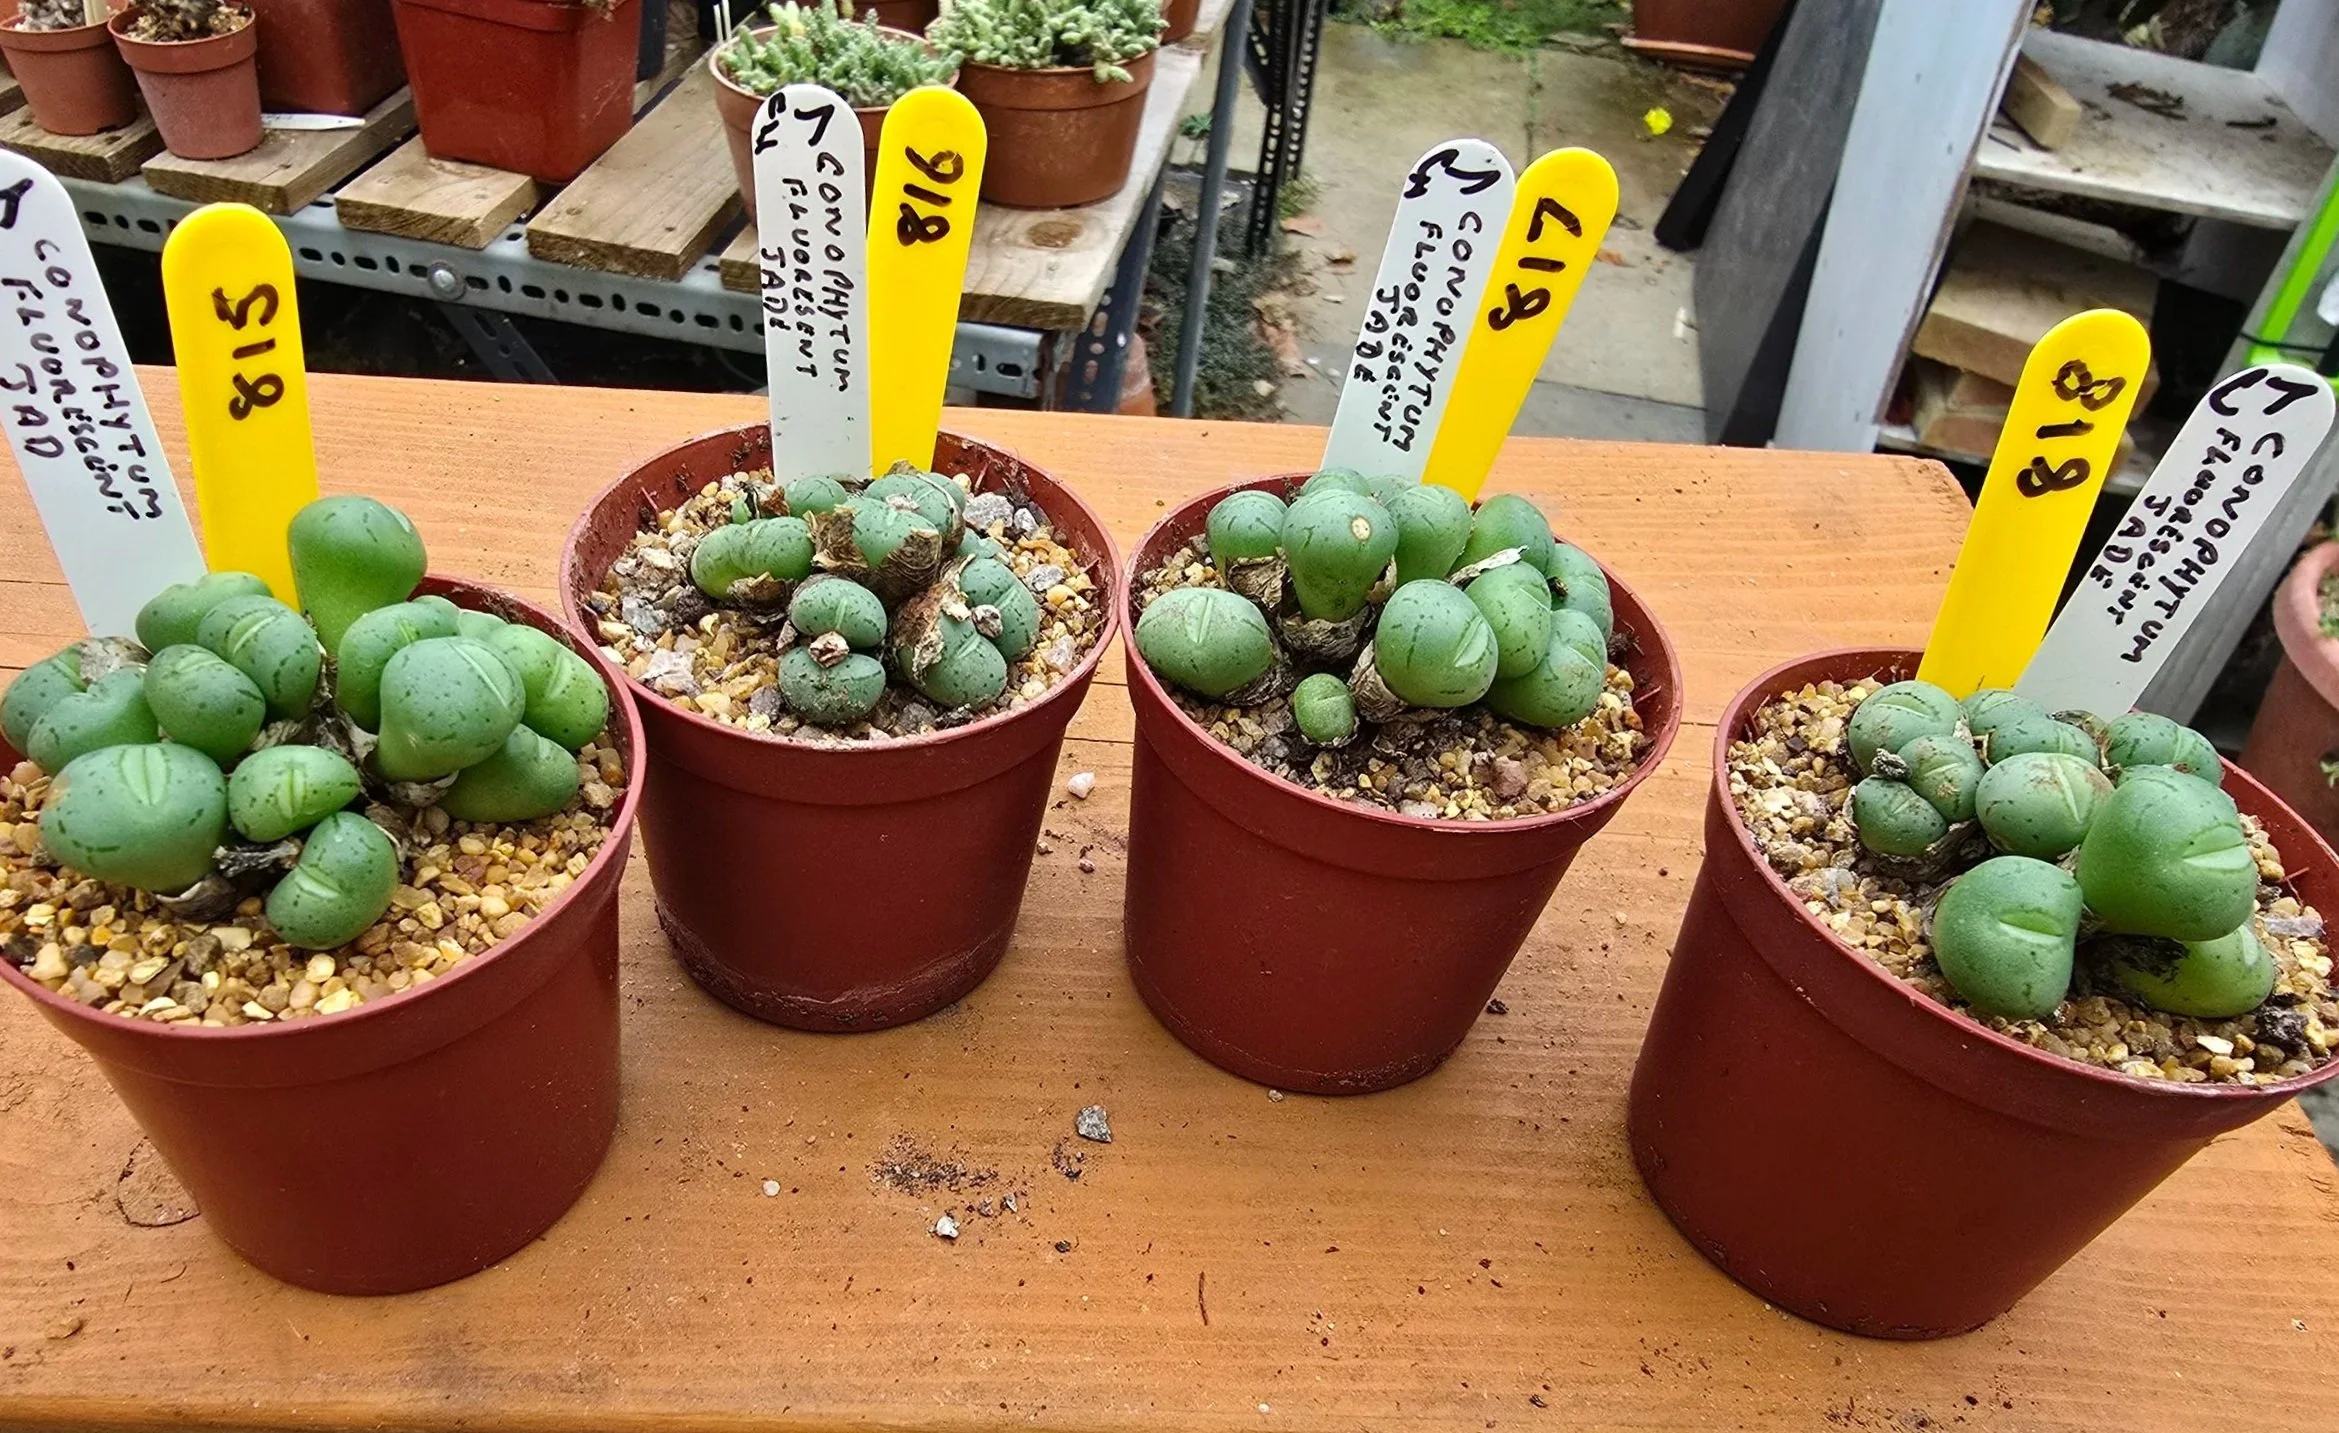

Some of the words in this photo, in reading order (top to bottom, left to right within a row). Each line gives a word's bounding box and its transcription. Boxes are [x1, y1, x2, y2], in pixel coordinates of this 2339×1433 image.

[816, 152, 854, 392] CONOPHYTUM
[897, 147, 963, 246] 816
[1488, 198, 1582, 330] 817
[212, 285, 284, 420] 815
[760, 246, 791, 331] JADE
[1353, 285, 1400, 383] JADE
[1373, 220, 1443, 442] FLUORESCENT
[1393, 211, 1482, 452] CONOPHYTUM
[2, 278, 140, 520] FLUORESCENT
[34, 239, 163, 519] CONOPHYTUM
[2017, 360, 2126, 497] 818
[2090, 495, 2171, 589] JADE
[2107, 427, 2241, 625] FLUORESCENT
[2120, 432, 2286, 663] CONOPHYTUM
